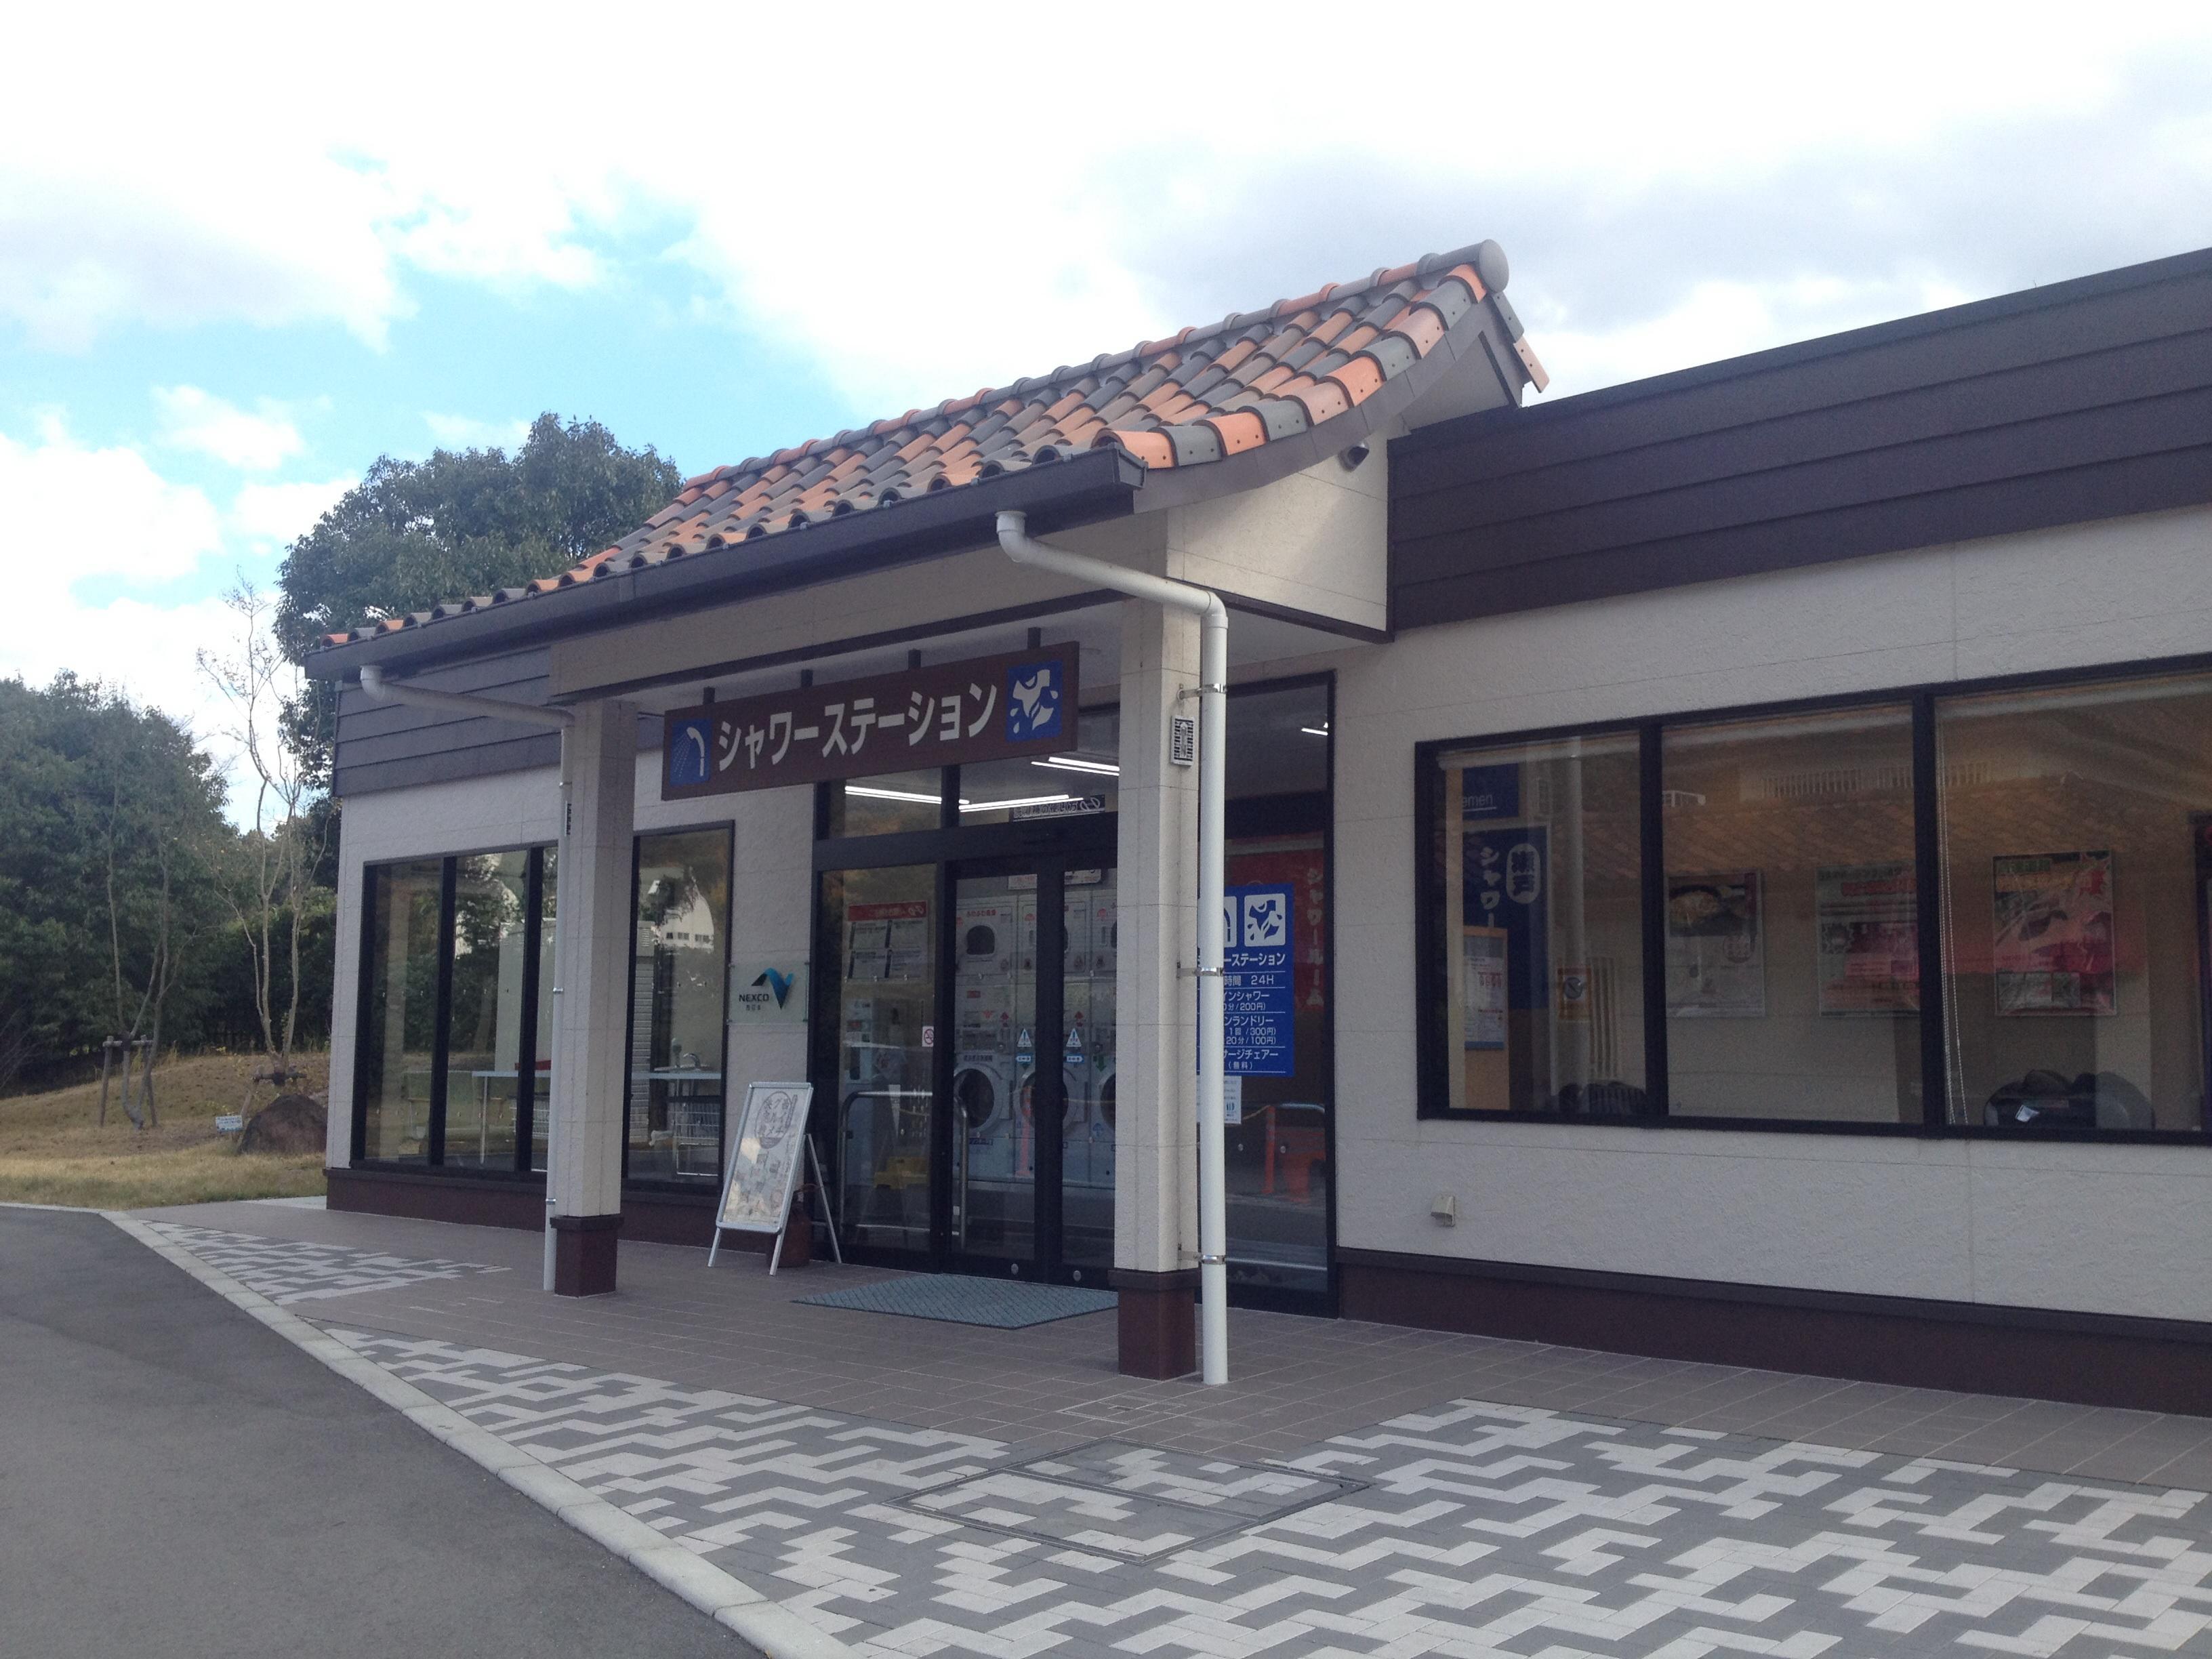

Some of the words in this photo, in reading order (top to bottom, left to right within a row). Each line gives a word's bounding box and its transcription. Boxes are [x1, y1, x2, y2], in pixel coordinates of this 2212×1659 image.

[718, 682, 997, 771] シャワーステーション
[1463, 794, 1493, 807] emen
[1224, 952, 1286, 966] ーステーション
[1224, 975, 1242, 987] 時間
[1250, 975, 1274, 985] 24H
[739, 994, 769, 1002] NEXCO
[1224, 991, 1270, 1001] ンシャワー
[1224, 1015, 1274, 1026] ンランドリー
